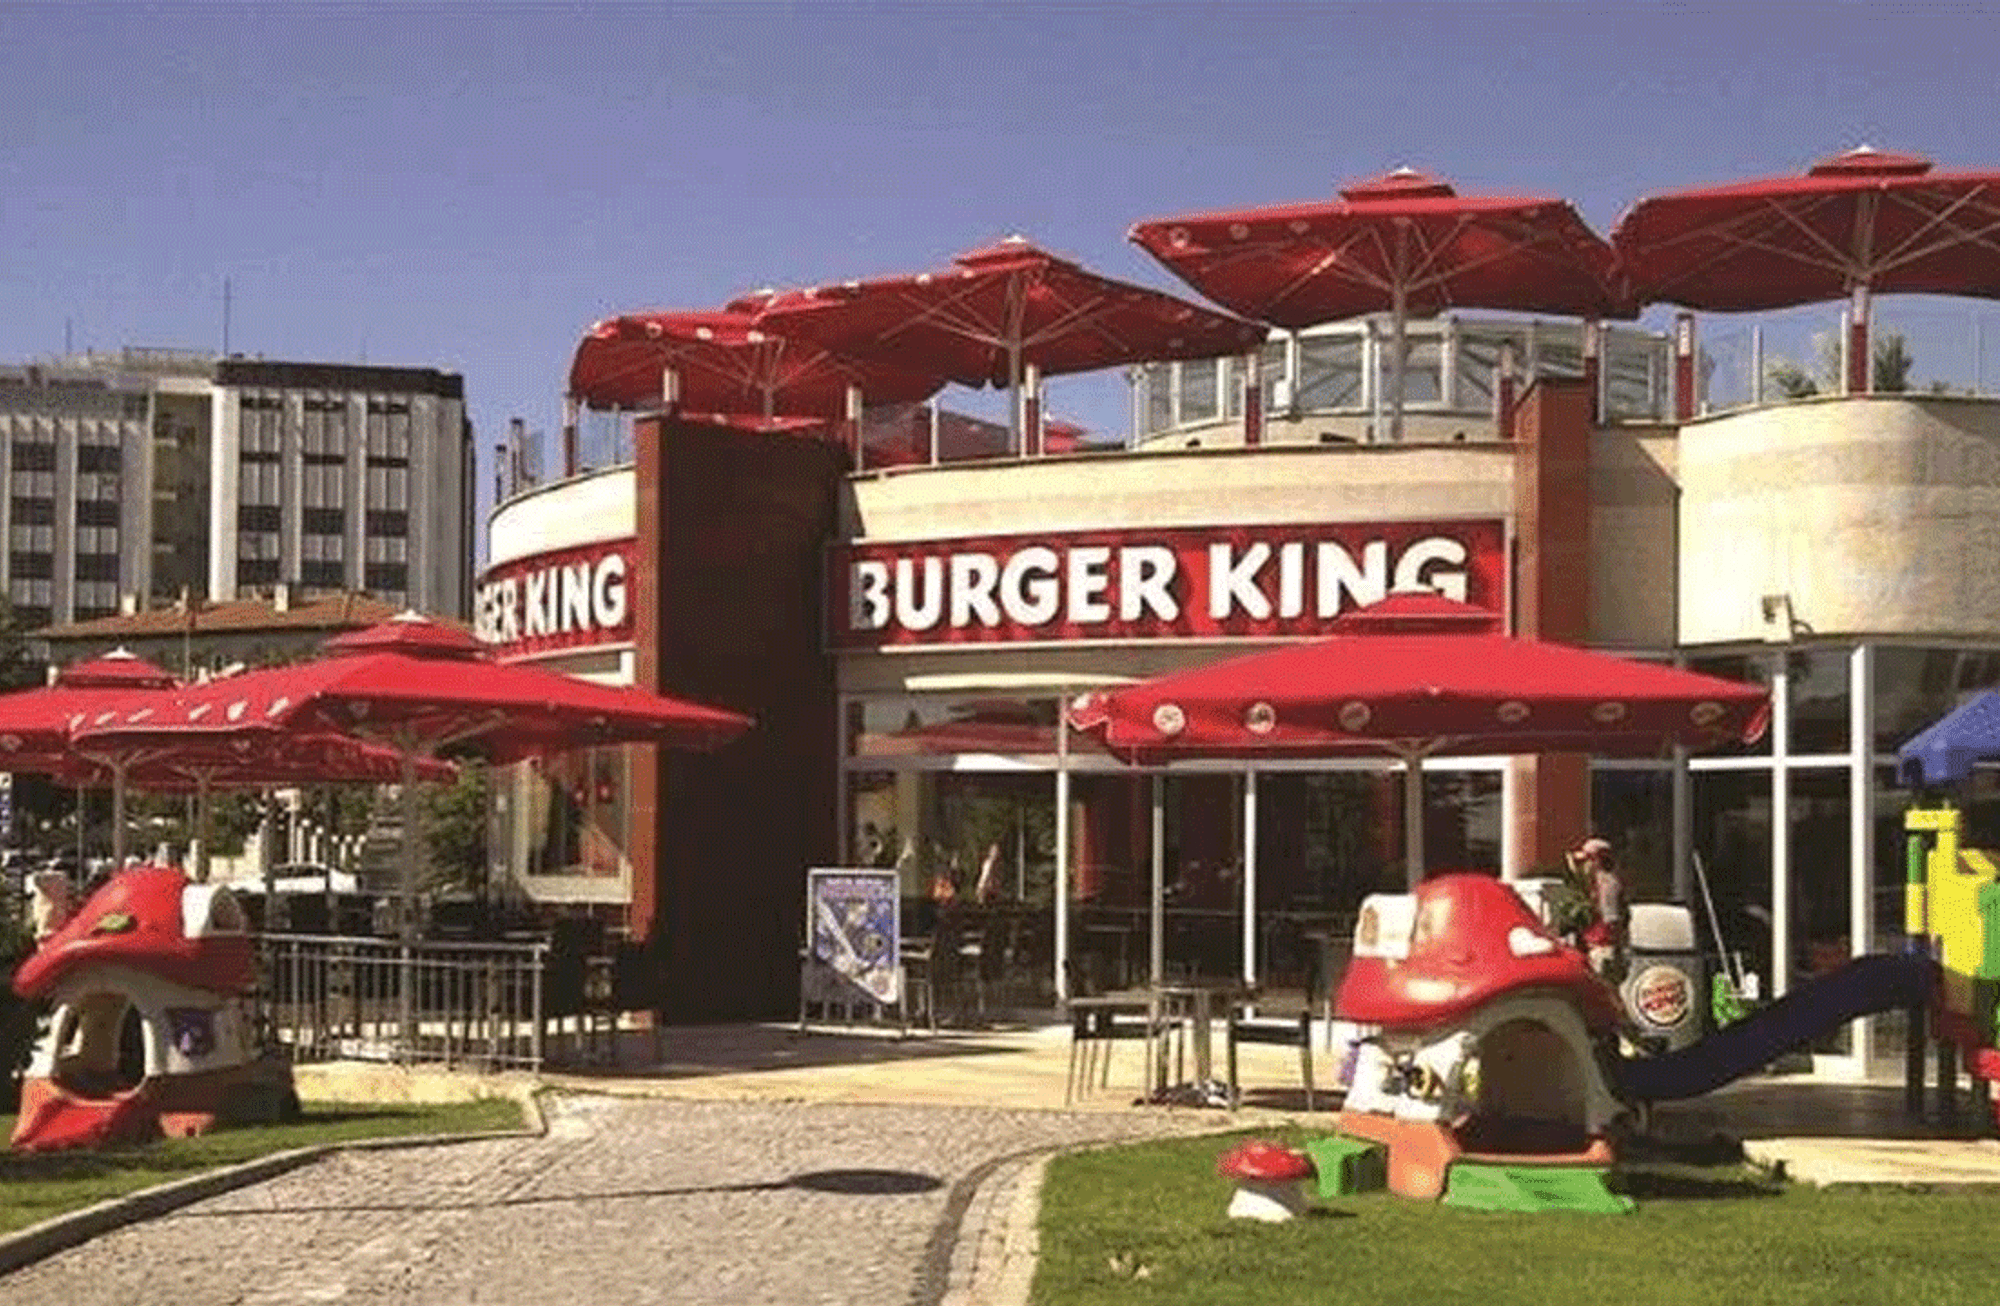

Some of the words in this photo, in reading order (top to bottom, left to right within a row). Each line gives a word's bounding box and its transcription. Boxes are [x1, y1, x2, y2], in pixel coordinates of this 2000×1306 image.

[525, 554, 626, 637] KING
[849, 547, 1179, 631] BURGER
[1209, 537, 1467, 619] KING
